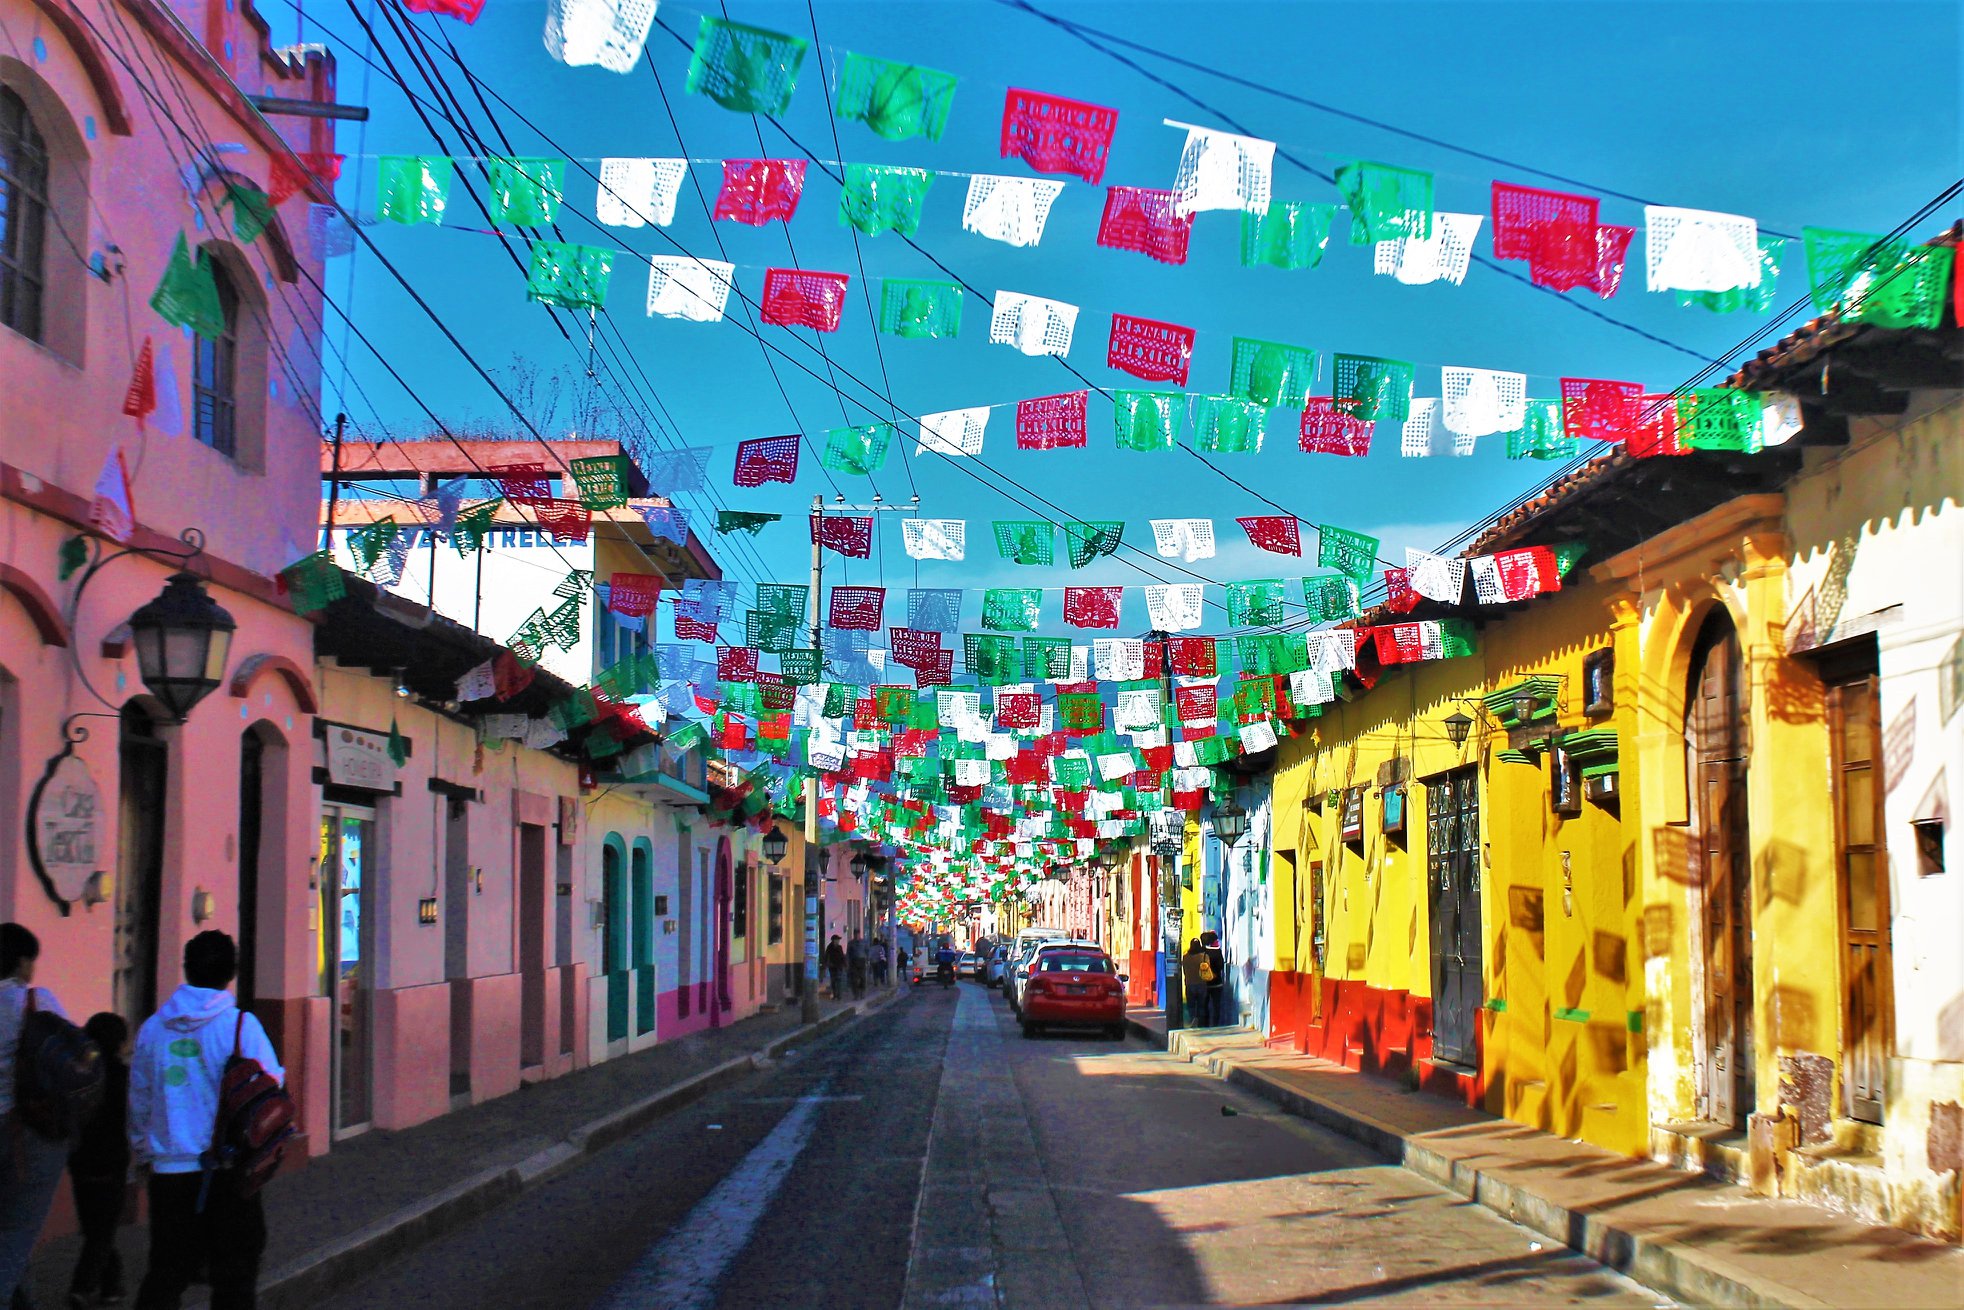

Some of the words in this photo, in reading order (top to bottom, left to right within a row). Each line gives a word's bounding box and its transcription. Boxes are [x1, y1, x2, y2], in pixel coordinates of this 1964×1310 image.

[1119, 318, 1163, 339] REYNA
[1117, 342, 1179, 366] MEXICO
[1024, 419, 1078, 432] MEXICO
[894, 629, 921, 641] REYNA
